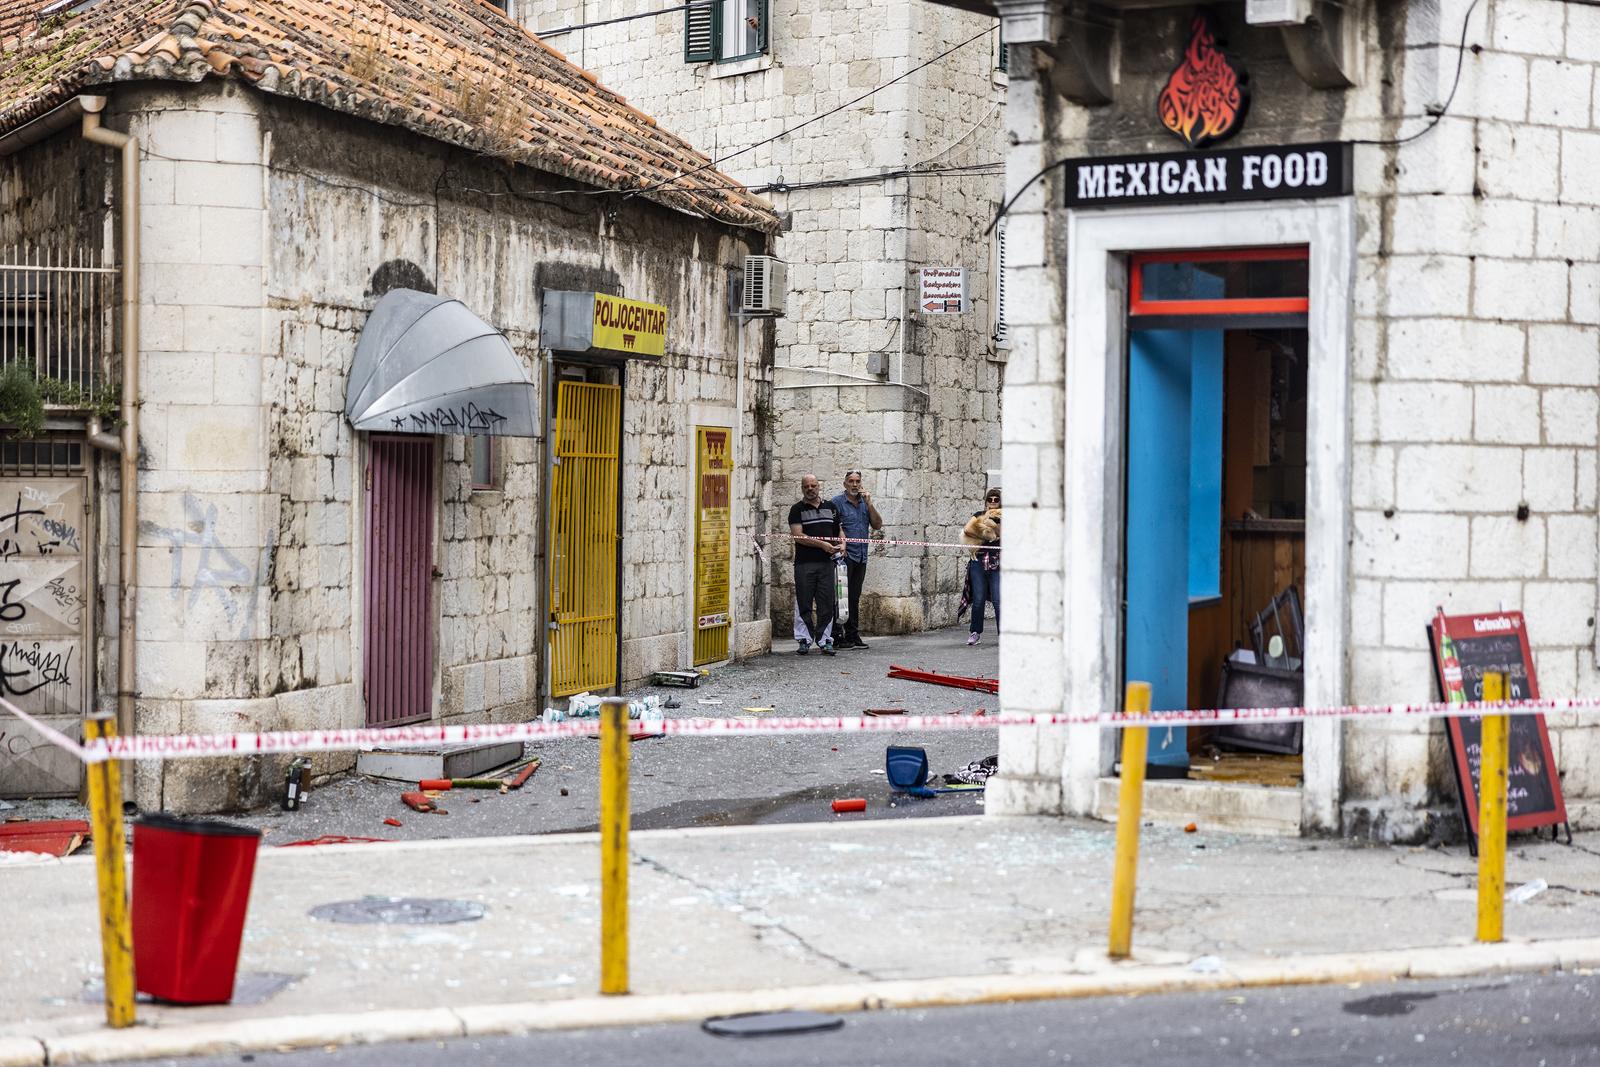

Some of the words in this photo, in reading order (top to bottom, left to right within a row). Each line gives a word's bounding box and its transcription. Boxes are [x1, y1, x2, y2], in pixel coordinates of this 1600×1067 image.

[1077, 157, 1227, 199] MEXICAN
[1242, 151, 1328, 190] FOOD
[595, 299, 666, 336] POLJOCENTAR
